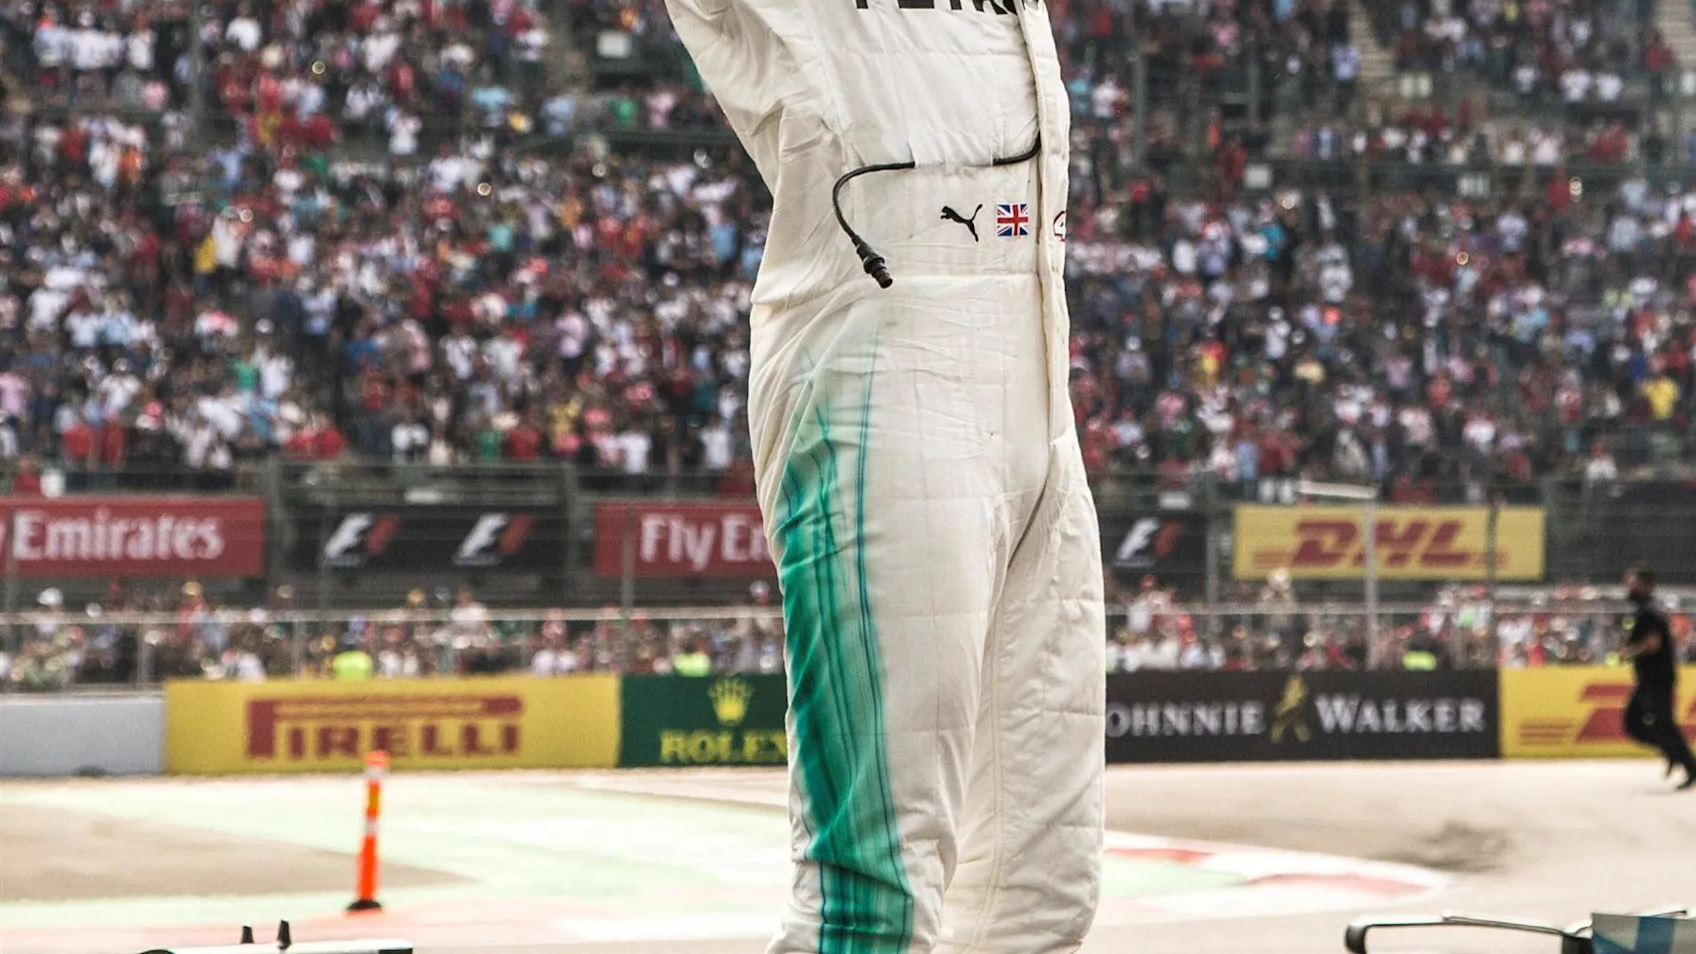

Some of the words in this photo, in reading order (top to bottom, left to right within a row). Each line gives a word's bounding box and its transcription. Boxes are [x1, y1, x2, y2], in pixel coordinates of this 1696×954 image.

[12, 510, 225, 561] Emirates
[640, 513, 717, 572] Fly
[1292, 519, 1466, 568] DHL
[246, 696, 523, 760] PIRELLI
[1105, 700, 1266, 738] OHNNIE
[1314, 694, 1486, 734] WALKER
